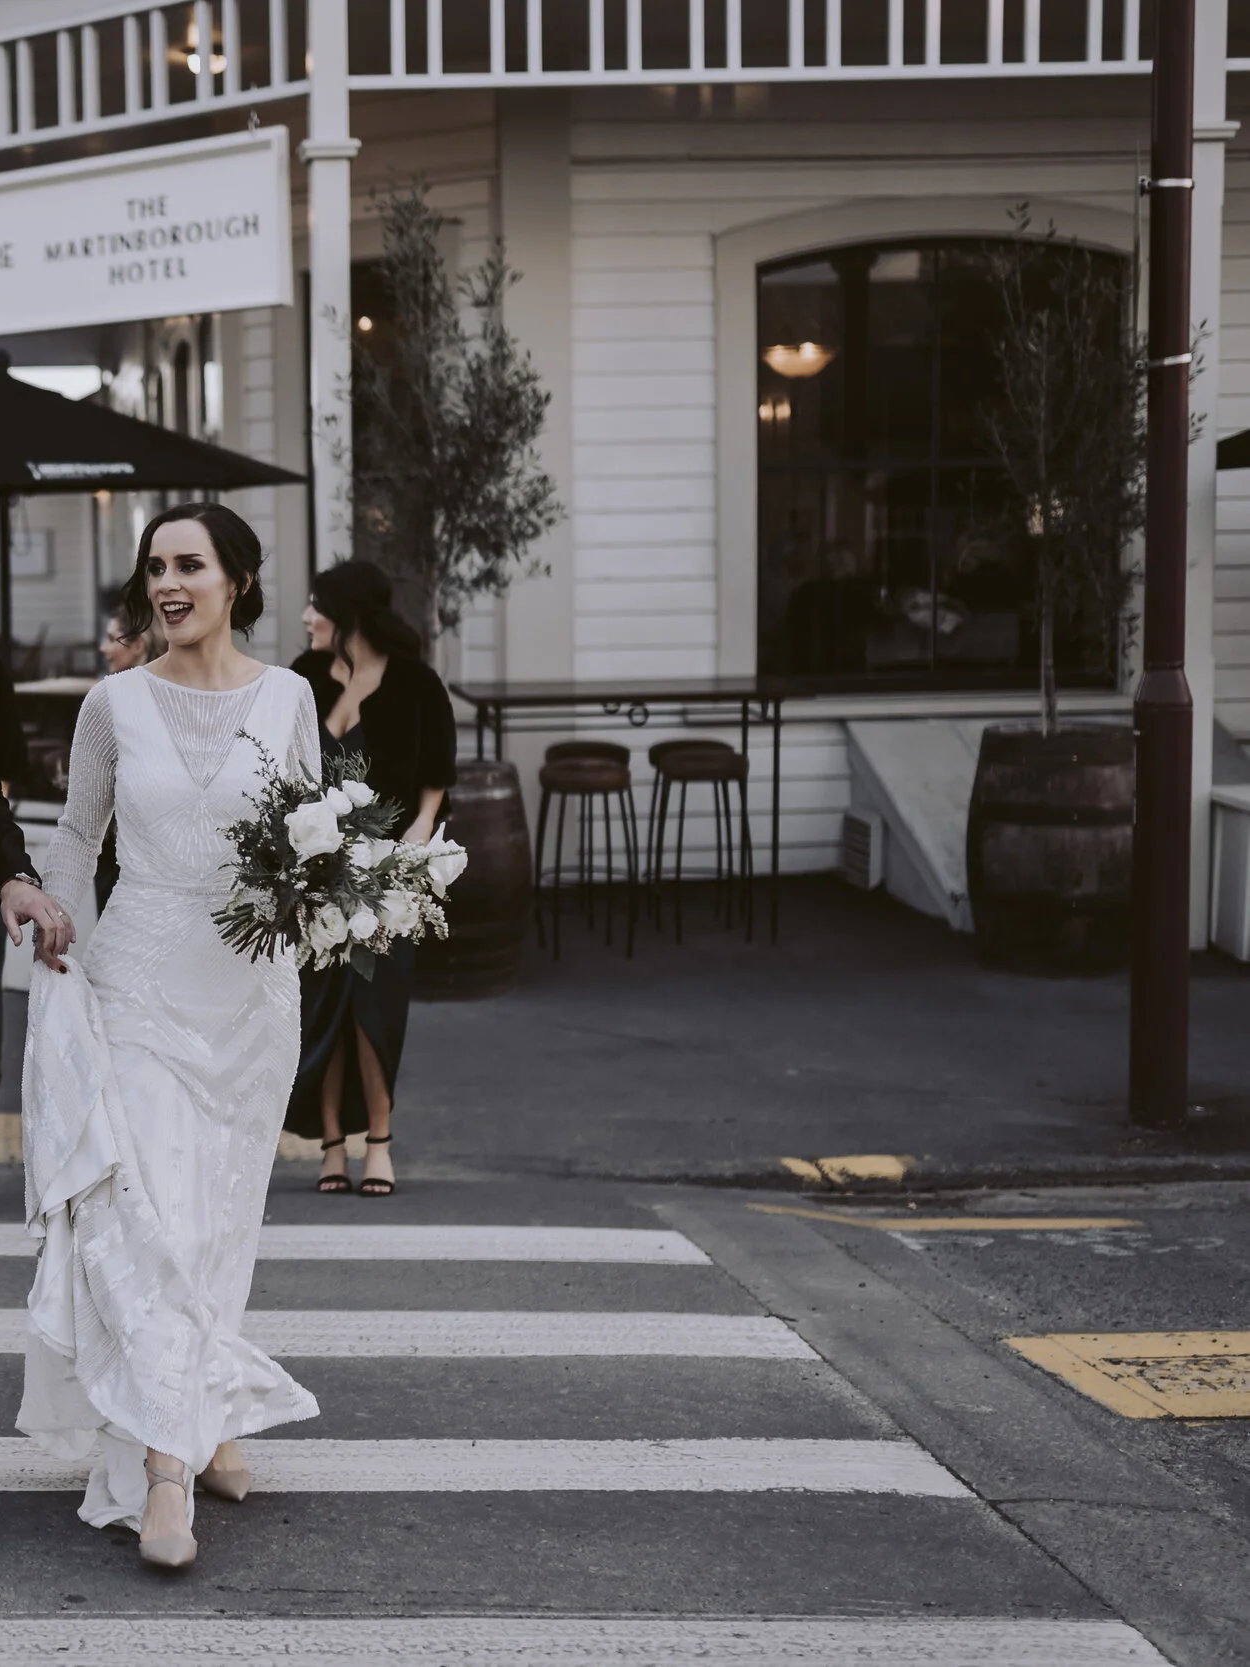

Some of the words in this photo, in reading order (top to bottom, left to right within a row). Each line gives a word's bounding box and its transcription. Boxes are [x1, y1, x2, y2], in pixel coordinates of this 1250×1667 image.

[124, 195, 168, 221] THE
[44, 214, 260, 261] MARTINBOROUGH
[107, 257, 187, 286] HOTEL
